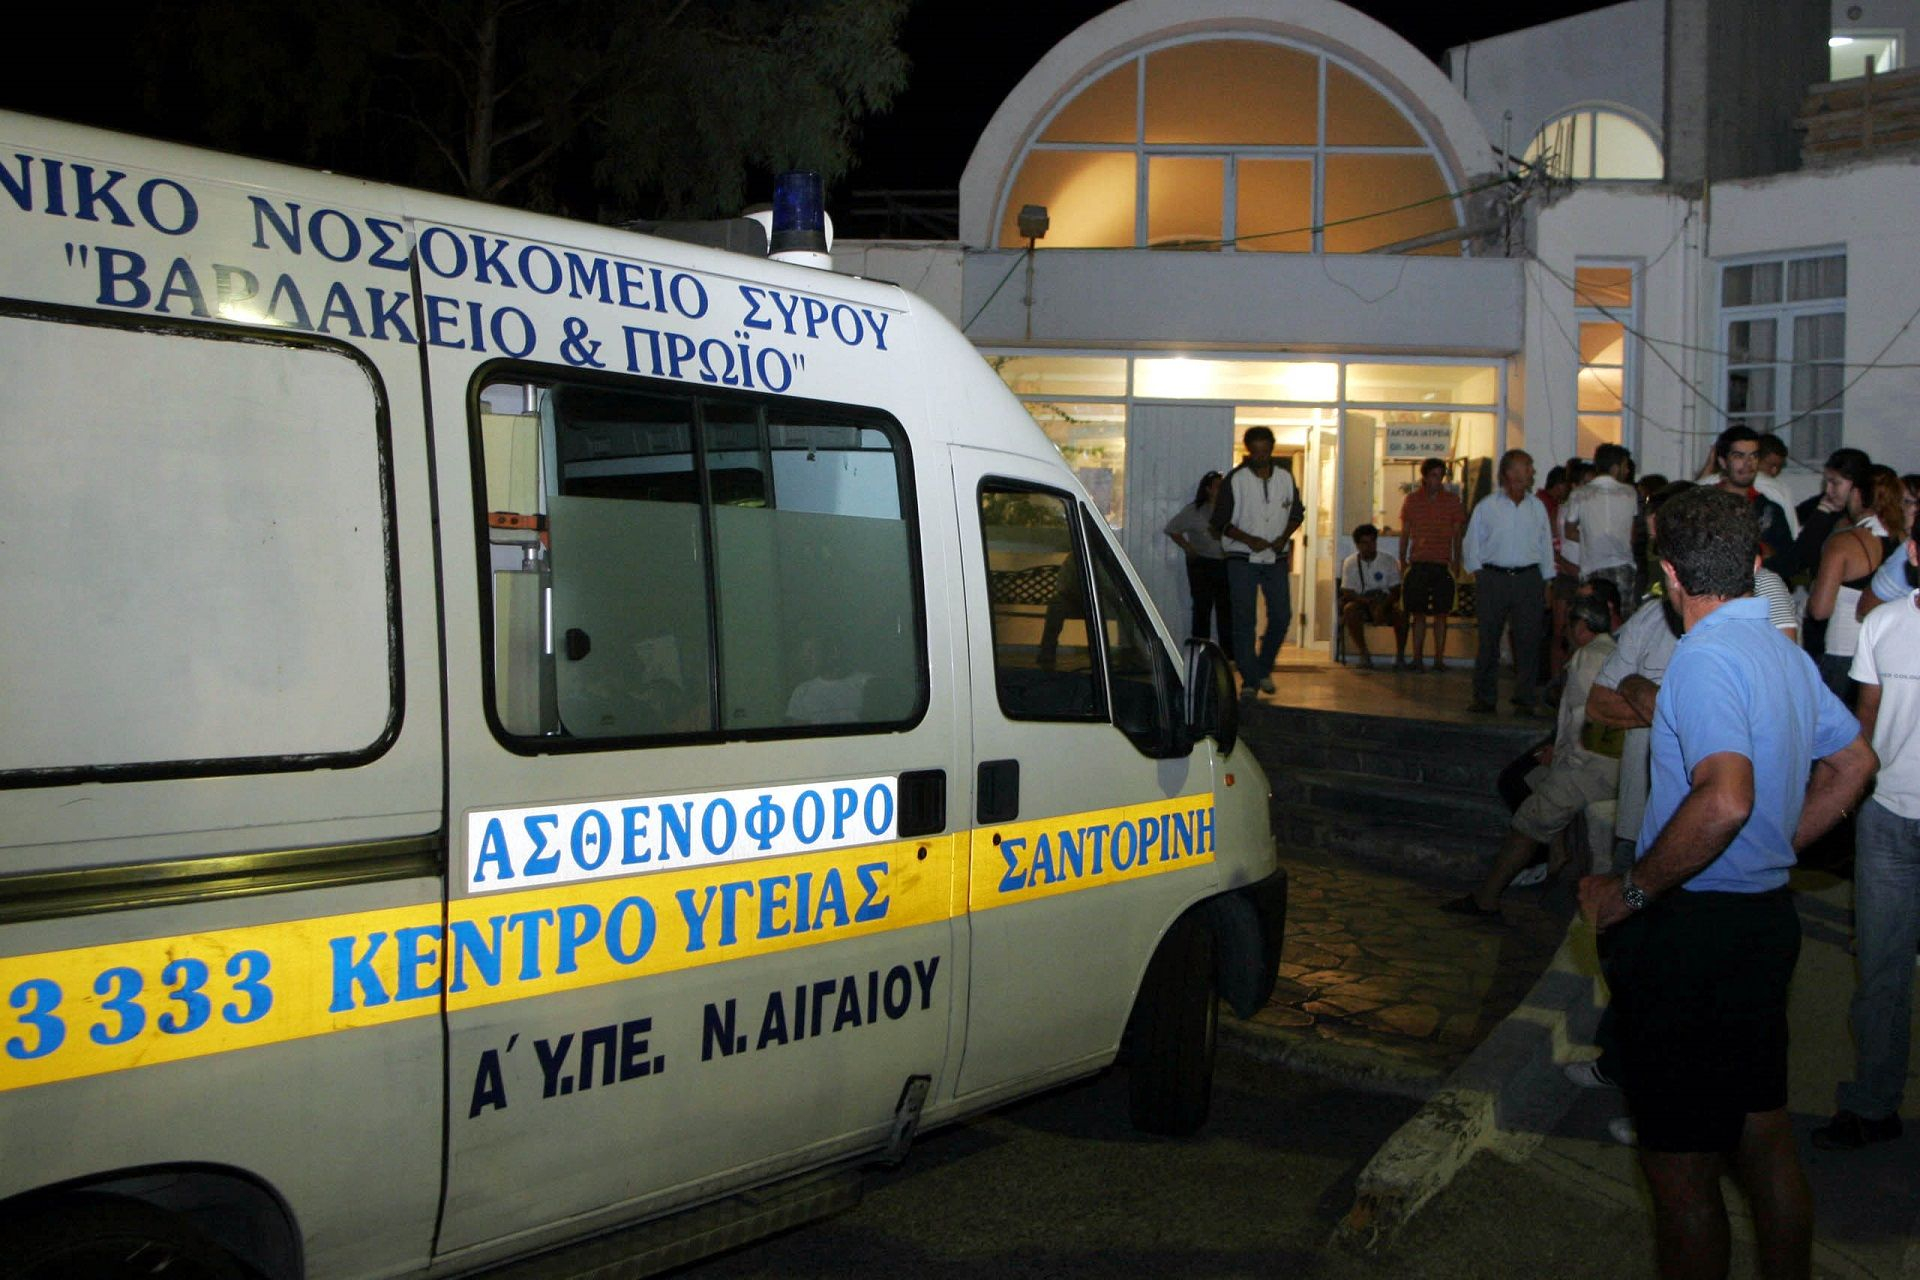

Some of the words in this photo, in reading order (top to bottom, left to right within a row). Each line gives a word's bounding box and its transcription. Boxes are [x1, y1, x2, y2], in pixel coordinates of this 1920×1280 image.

[247, 195, 709, 320] ΝΟΣΟΚΟΜΕΙΟ
[737, 284, 889, 351] ΣΥΡΟΥ
[558, 316, 606, 368] &
[473, 783, 894, 883] ΑΣΘΕΝΟΦΟΡΟ
[328, 895, 657, 1014] ΚΕΝΤΡΟ
[675, 862, 890, 953] ΥΓΕΙΑΣ
[998, 806, 1215, 893] ΣΑΝΤΟΡΙΝΗ
